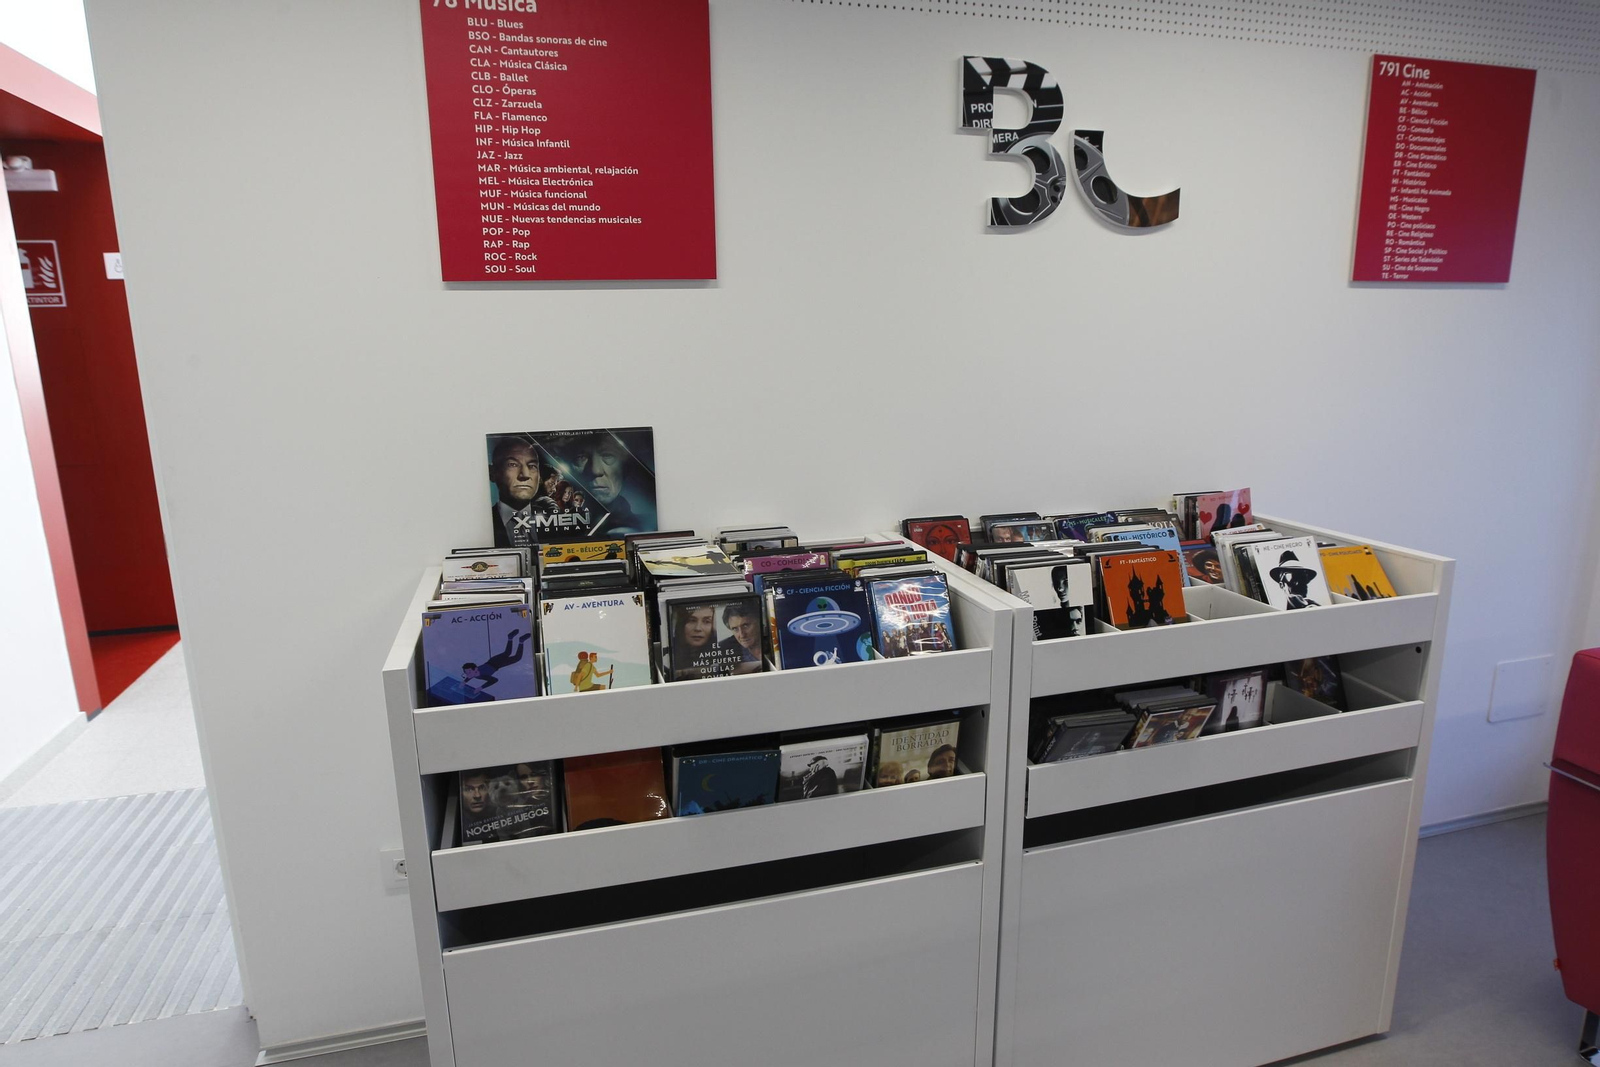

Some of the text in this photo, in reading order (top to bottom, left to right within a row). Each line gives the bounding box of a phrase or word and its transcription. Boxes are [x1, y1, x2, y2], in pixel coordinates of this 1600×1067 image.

[467, 17, 523, 29] BLU Blues
[468, 30, 607, 47] BSO Bandas sonoras de cine
[469, 44, 558, 57] CAN Cantautores
[470, 57, 567, 70] CLA Música Clásica
[1379, 61, 1430, 79] 791 Cine
[471, 71, 528, 82] CLB Ballet
[472, 84, 536, 97] CLO Óperas
[472, 97, 542, 109] CLZ Zarzuela
[474, 111, 547, 122] FLA Flamenco
[475, 124, 541, 136] HIP Hip Hop
[476, 137, 570, 148] INF Música Infantil
[476, 150, 523, 160] JAZ Jazz
[477, 163, 638, 176] MAR Música ambiental, relajación
[1405, 160, 1417, 168] Cine
[479, 176, 593, 186] MEL Música Electrónica
[479, 189, 587, 198] MUF Música funcional
[480, 202, 600, 211] MUN Músicas del mundo
[481, 214, 641, 224] NUE Nuevas tendencias musicales
[482, 227, 530, 237] POP Pop
[483, 240, 529, 250] RAP Rap
[484, 252, 537, 261] ROC Rock
[485, 264, 535, 273] SOU Soul
[513, 512, 591, 529] X-MEN
[514, 525, 591, 534] ORIGINAL
[1132, 531, 1168, 540] HISTÓRICO
[1128, 556, 1156, 564] FANTÁSTICO
[799, 586, 824, 594] CIENCIA
[825, 582, 850, 591] FICCIÓN
[582, 600, 624, 609] AVENTURA
[451, 612, 502, 624] AC ACCIÓN
[699, 650, 722, 658] AMOR
[692, 656, 742, 667] MÁS FUERTE
[892, 730, 950, 746] IDENTIDAD
[896, 738, 944, 752] BORRADA
[466, 821, 500, 838] NOCHE
[501, 818, 512, 827] DE
[514, 806, 549, 824] JUEGOS
